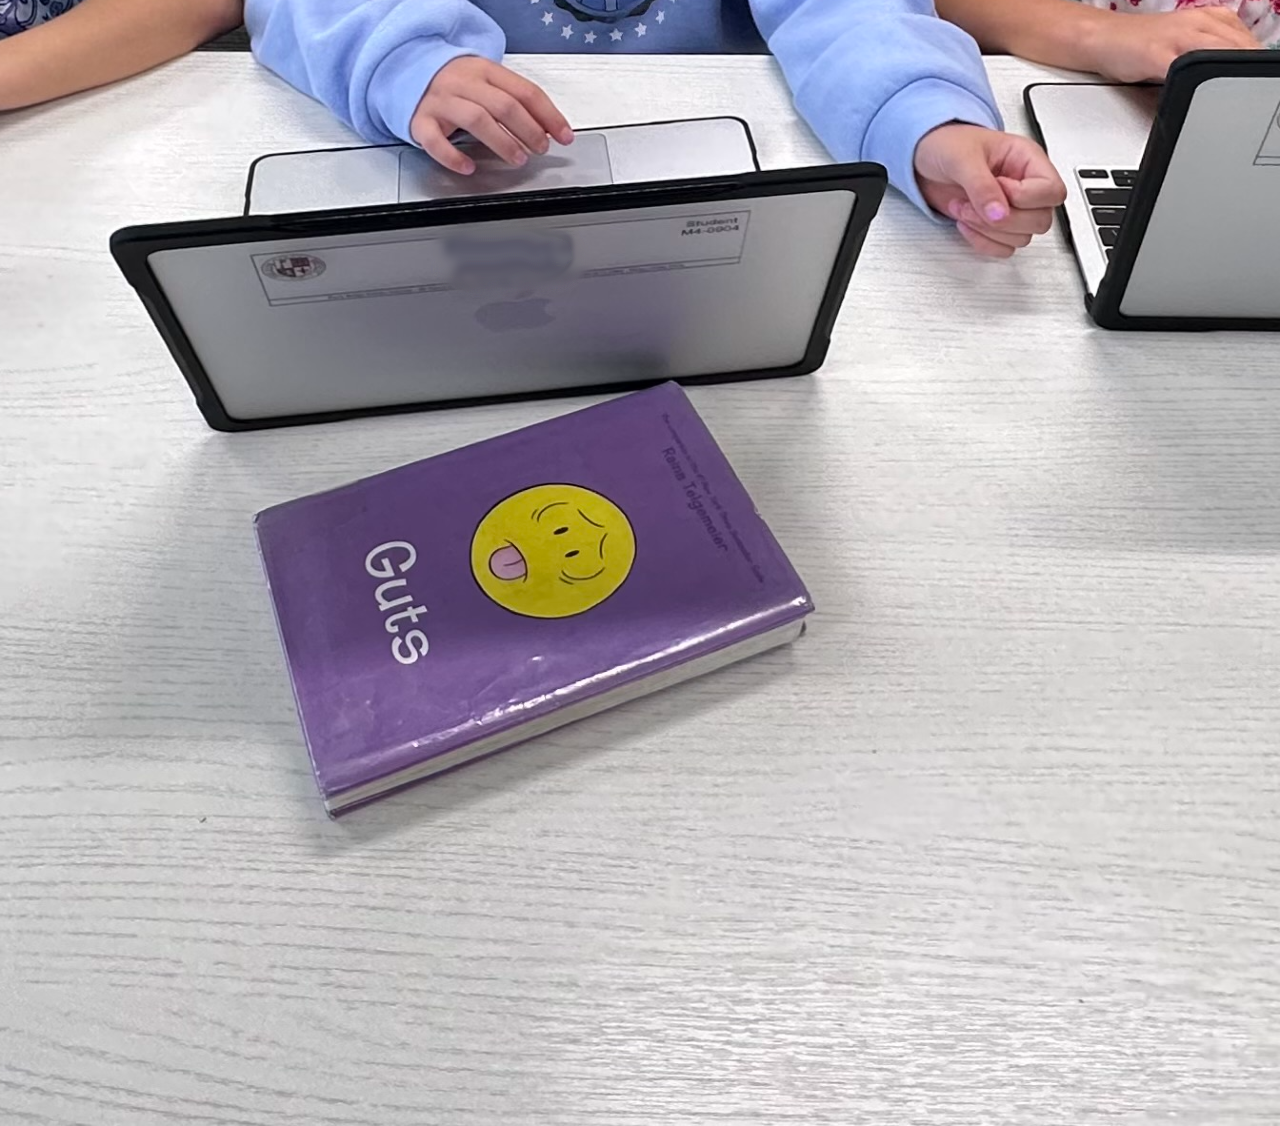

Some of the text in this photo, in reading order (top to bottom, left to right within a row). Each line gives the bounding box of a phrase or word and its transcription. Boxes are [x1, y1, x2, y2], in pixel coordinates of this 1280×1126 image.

[686, 216, 739, 228] Student
[662, 446, 729, 552] Raina Telgemeier
[365, 540, 430, 665] Guts
